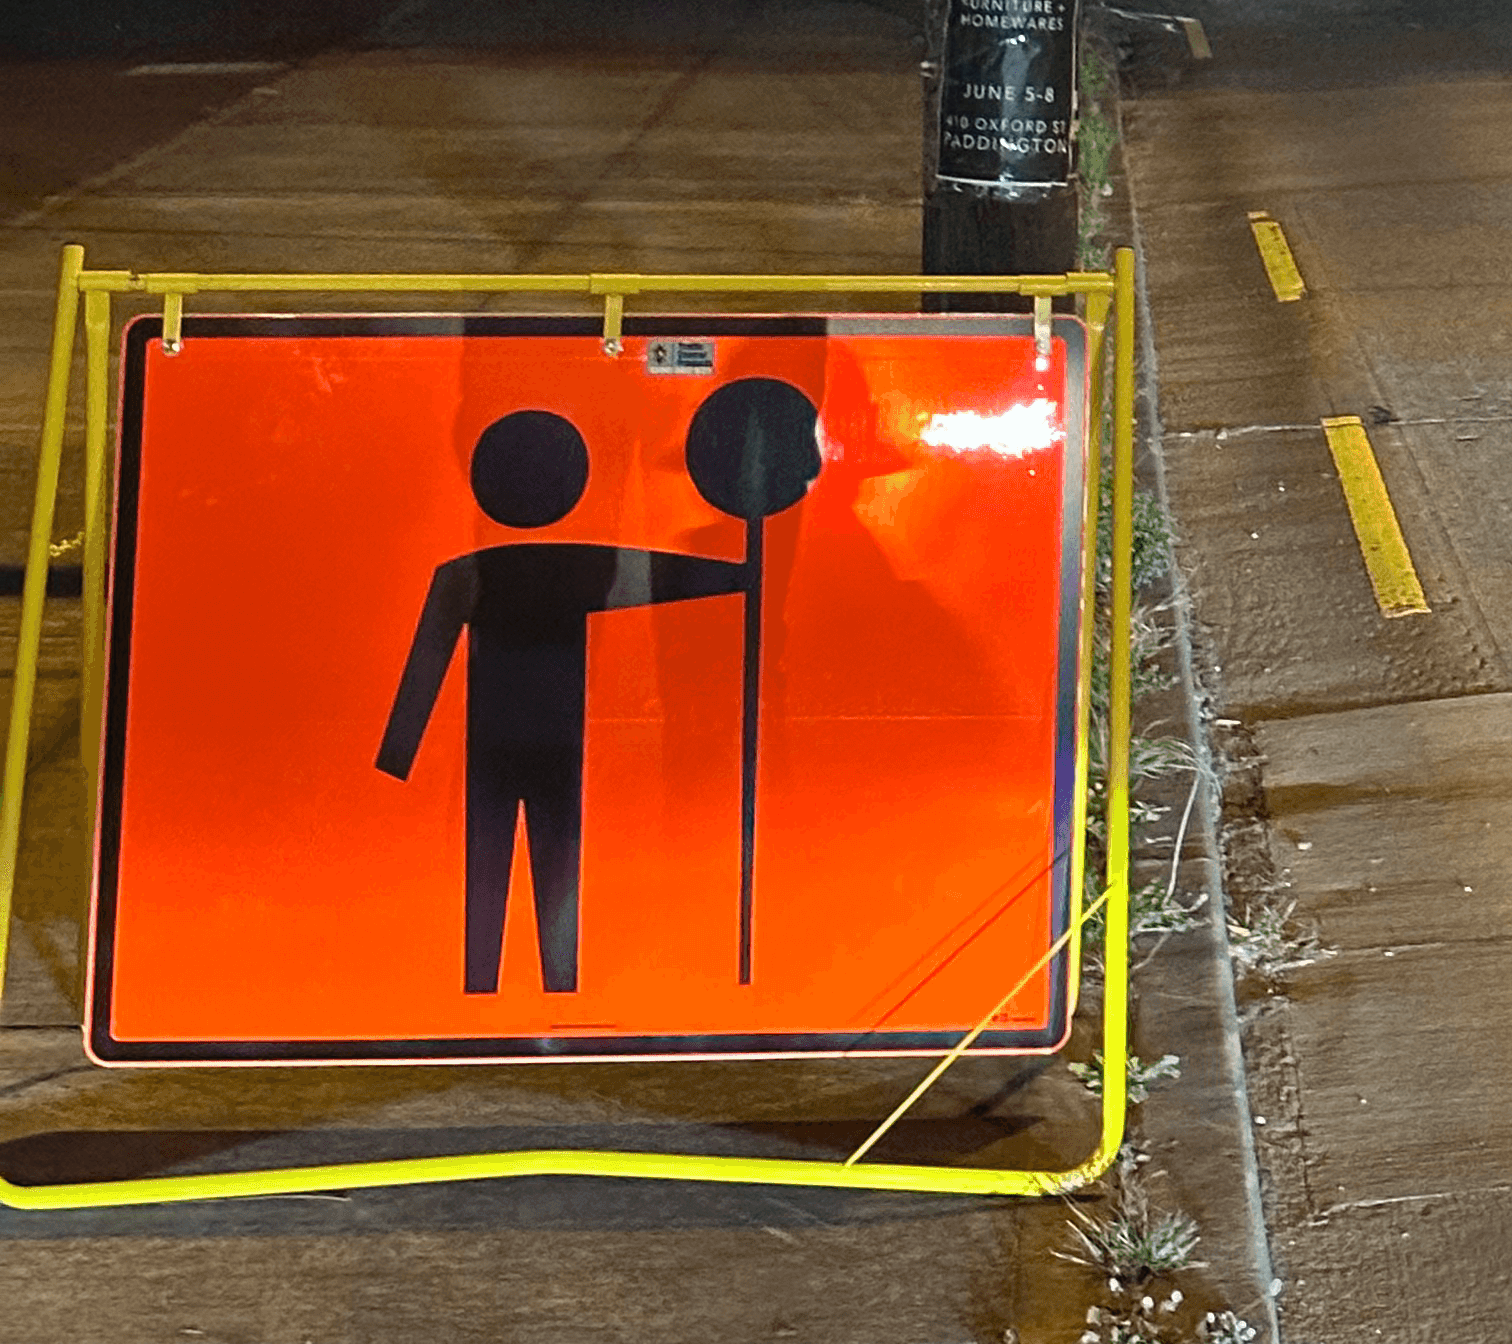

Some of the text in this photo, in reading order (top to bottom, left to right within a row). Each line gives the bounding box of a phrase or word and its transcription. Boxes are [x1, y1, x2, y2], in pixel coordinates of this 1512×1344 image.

[960, 13, 1064, 31] HOMEWARES
[963, 83, 1055, 104] JUNE 5-8
[974, 116, 1048, 135] OXFORD
